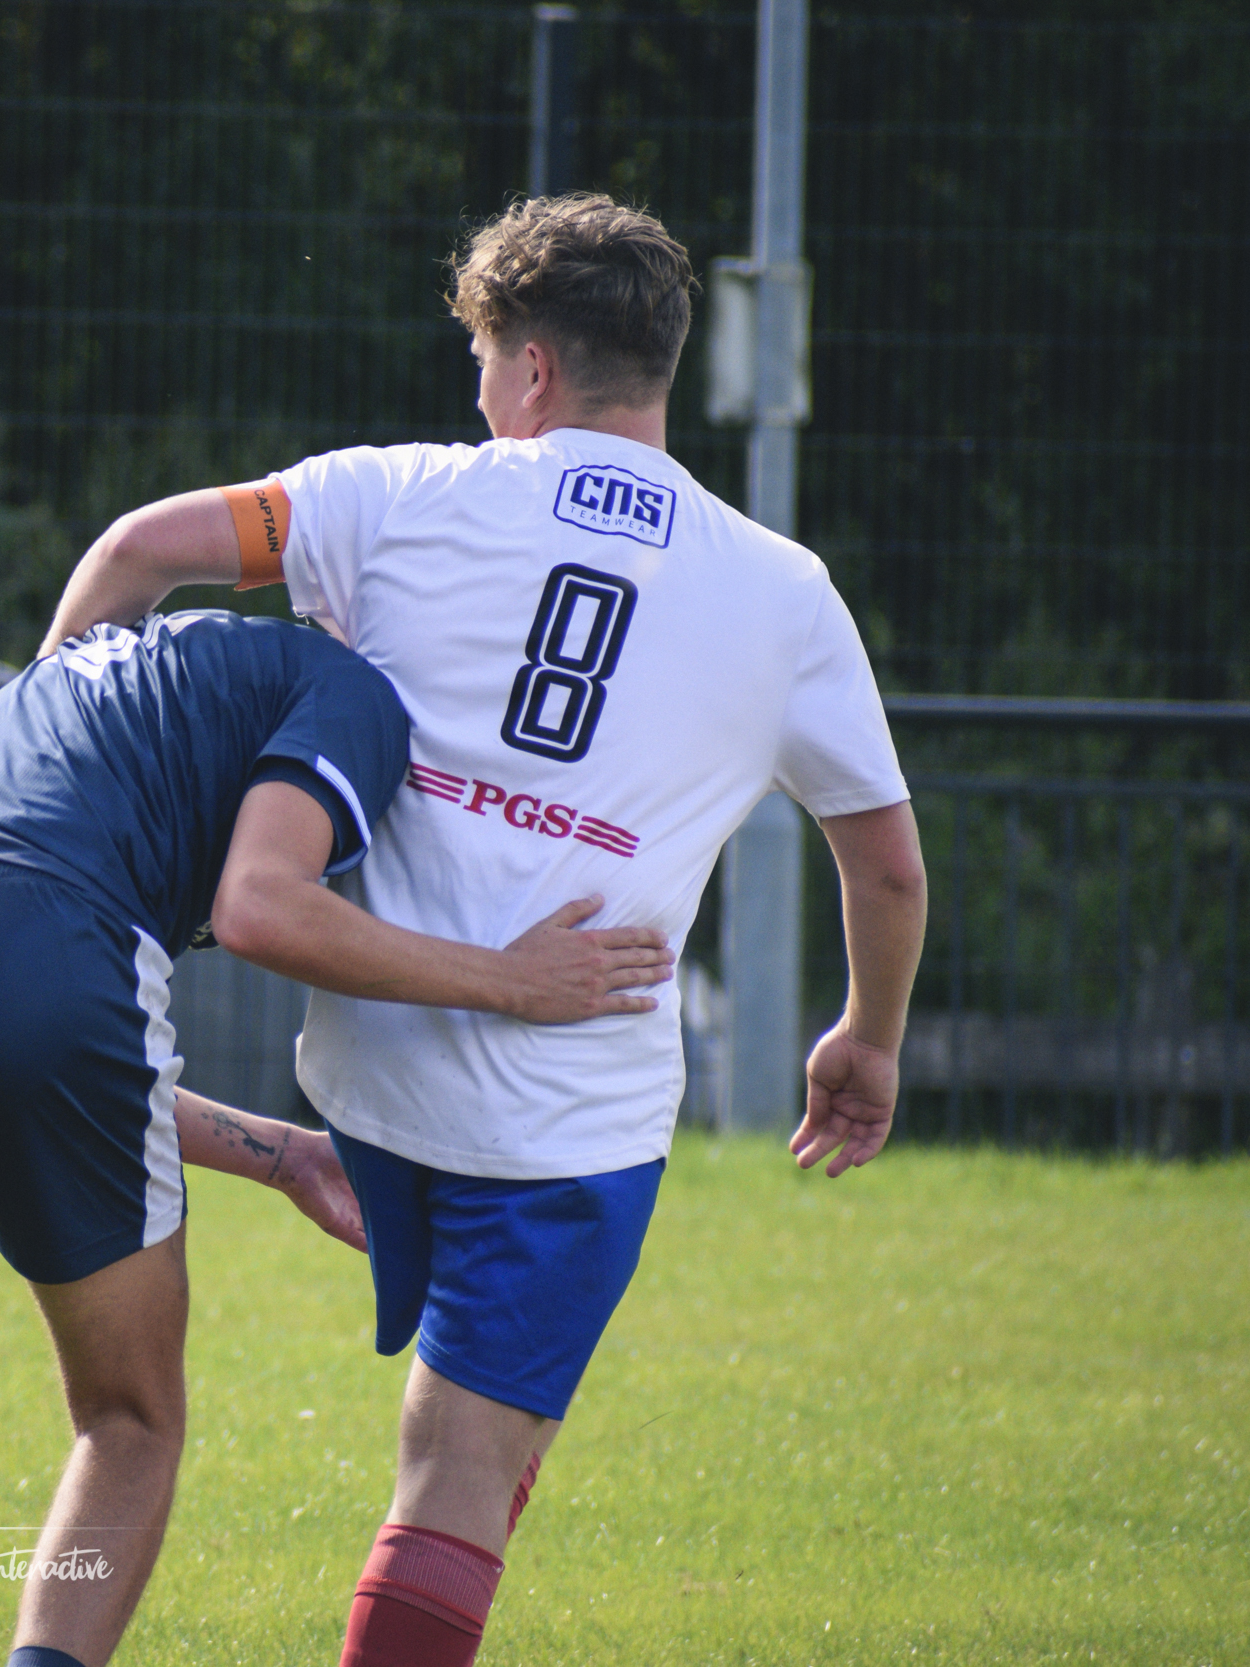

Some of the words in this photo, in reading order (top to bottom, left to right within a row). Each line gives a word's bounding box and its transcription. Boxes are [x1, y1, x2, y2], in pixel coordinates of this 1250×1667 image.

[254, 489, 280, 553] CAPTAIN
[570, 505, 656, 537] TEAMWEAR
[500, 562, 639, 764] 8
[463, 778, 578, 840] PGS
